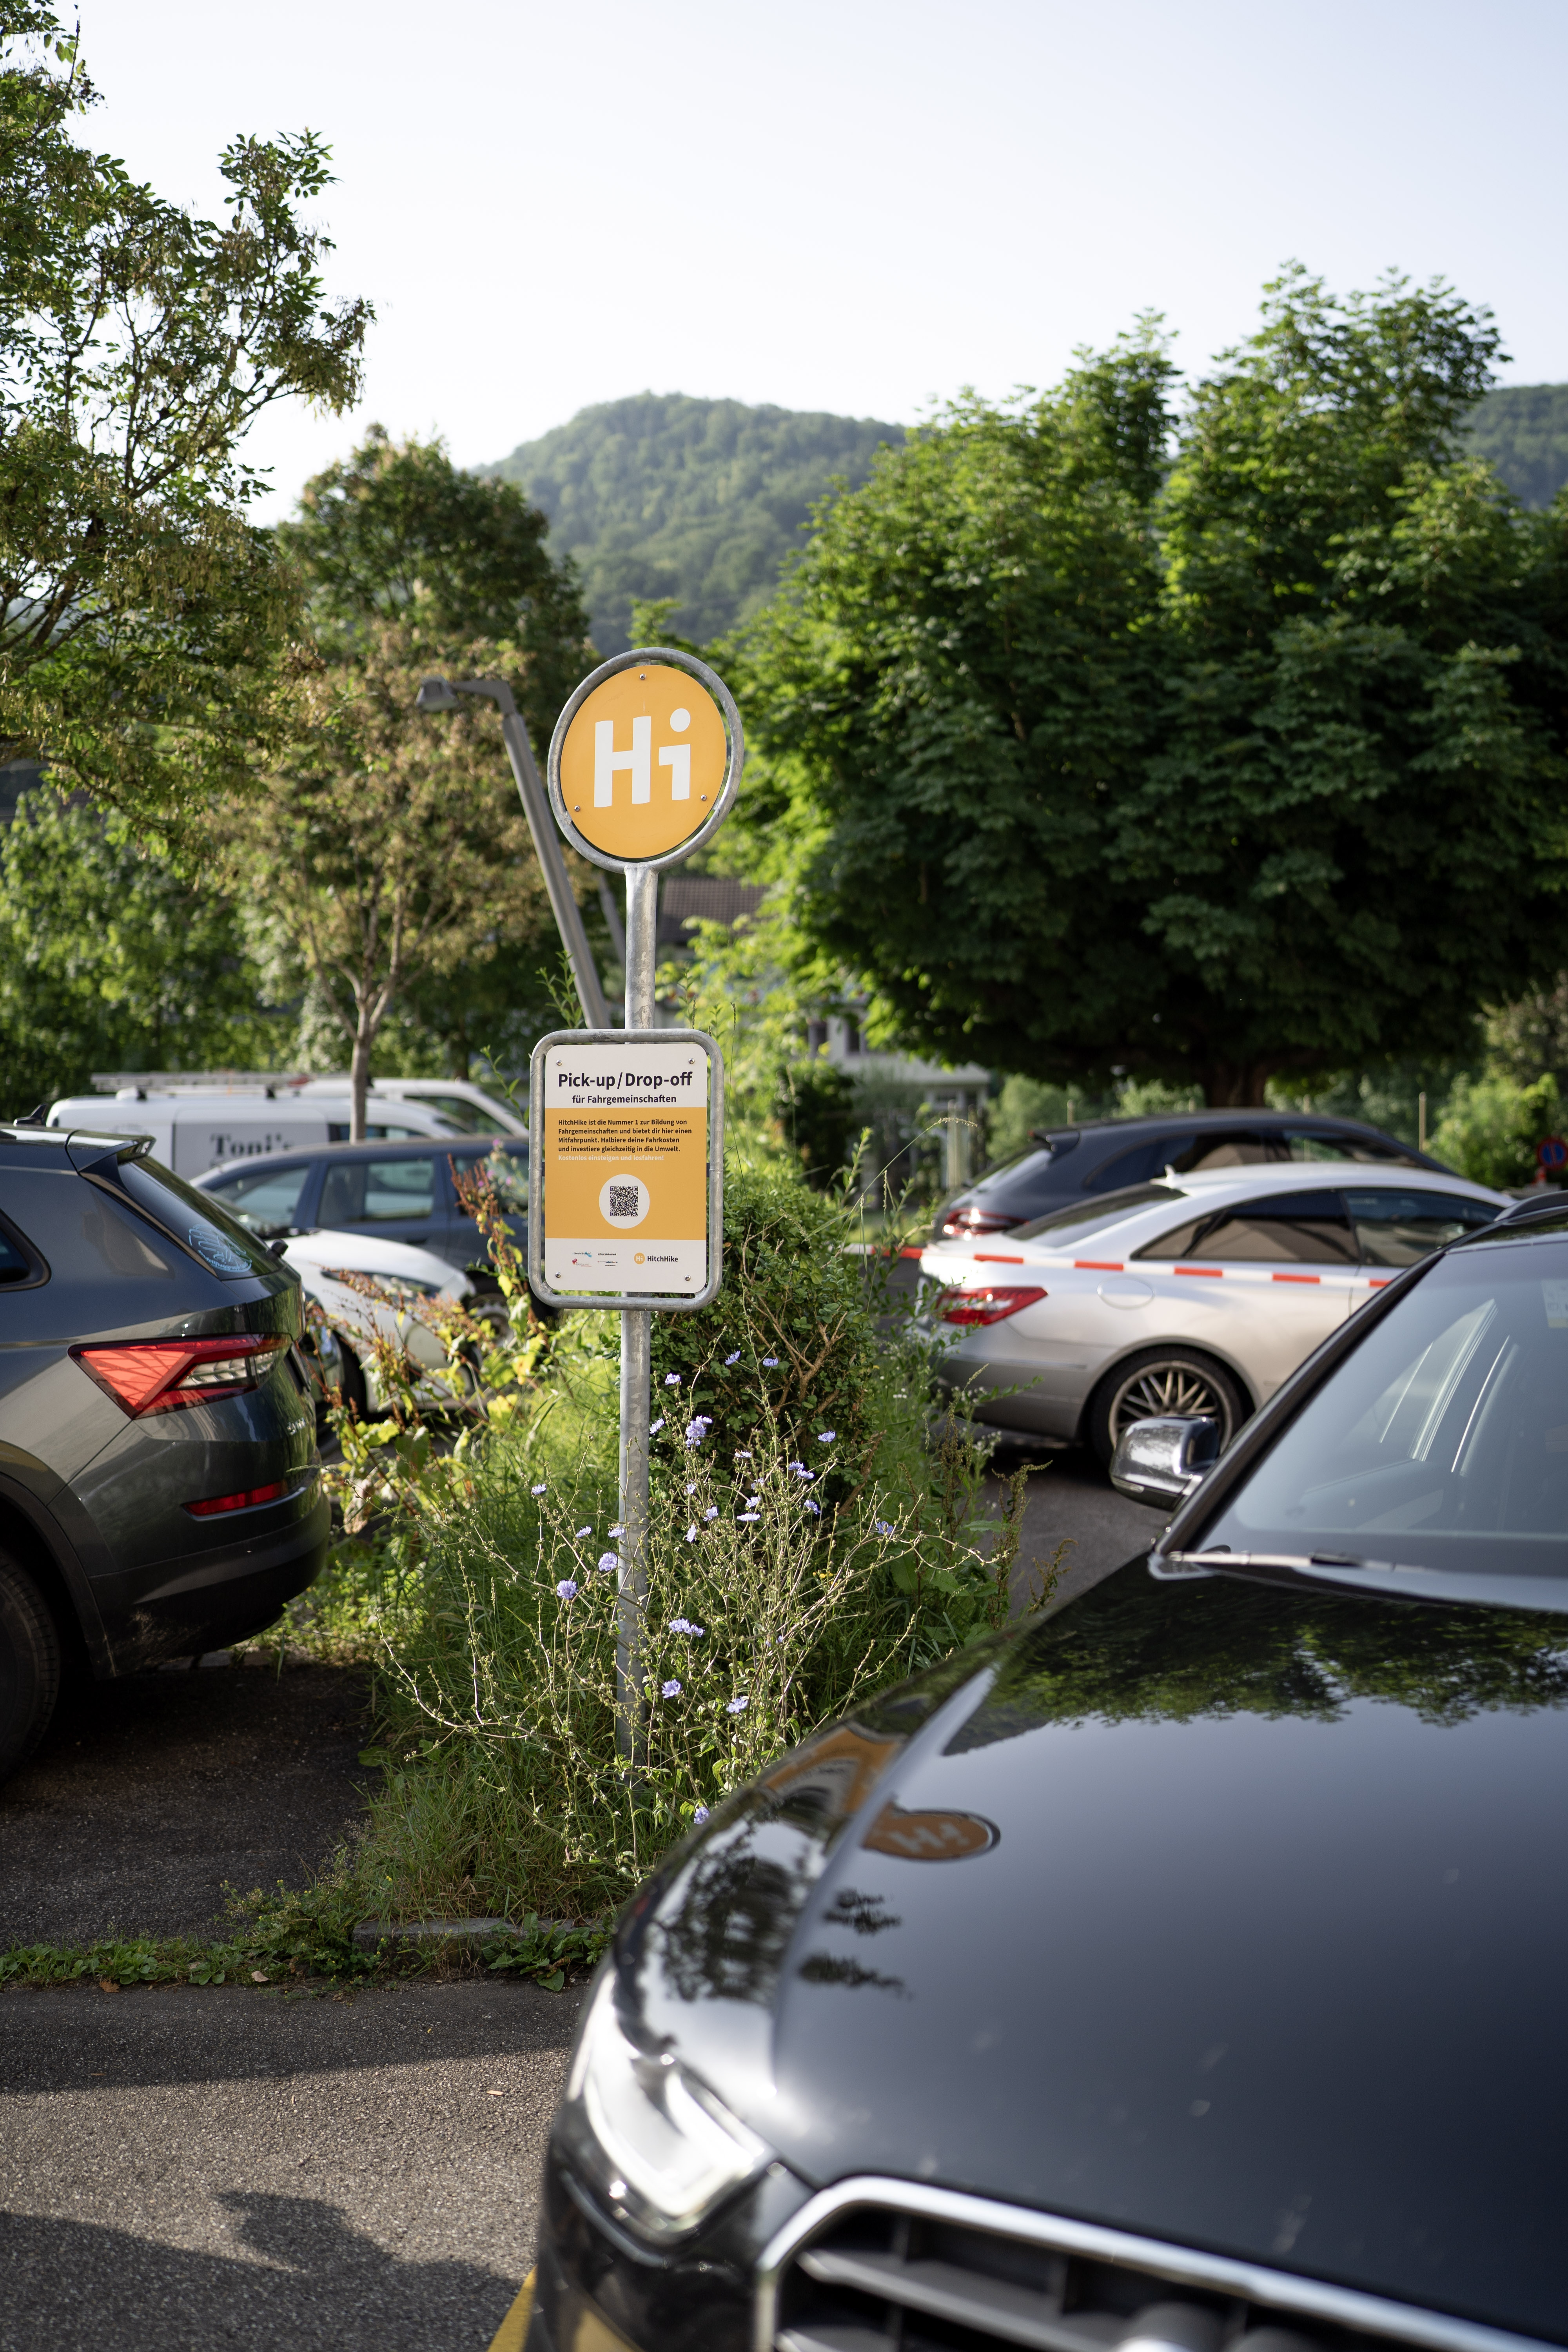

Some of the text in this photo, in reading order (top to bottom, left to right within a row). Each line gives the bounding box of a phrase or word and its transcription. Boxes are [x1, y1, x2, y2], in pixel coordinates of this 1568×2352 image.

[593, 708, 691, 808] Hi
[572, 1094, 676, 1105] für Fahrgemeinschaften
